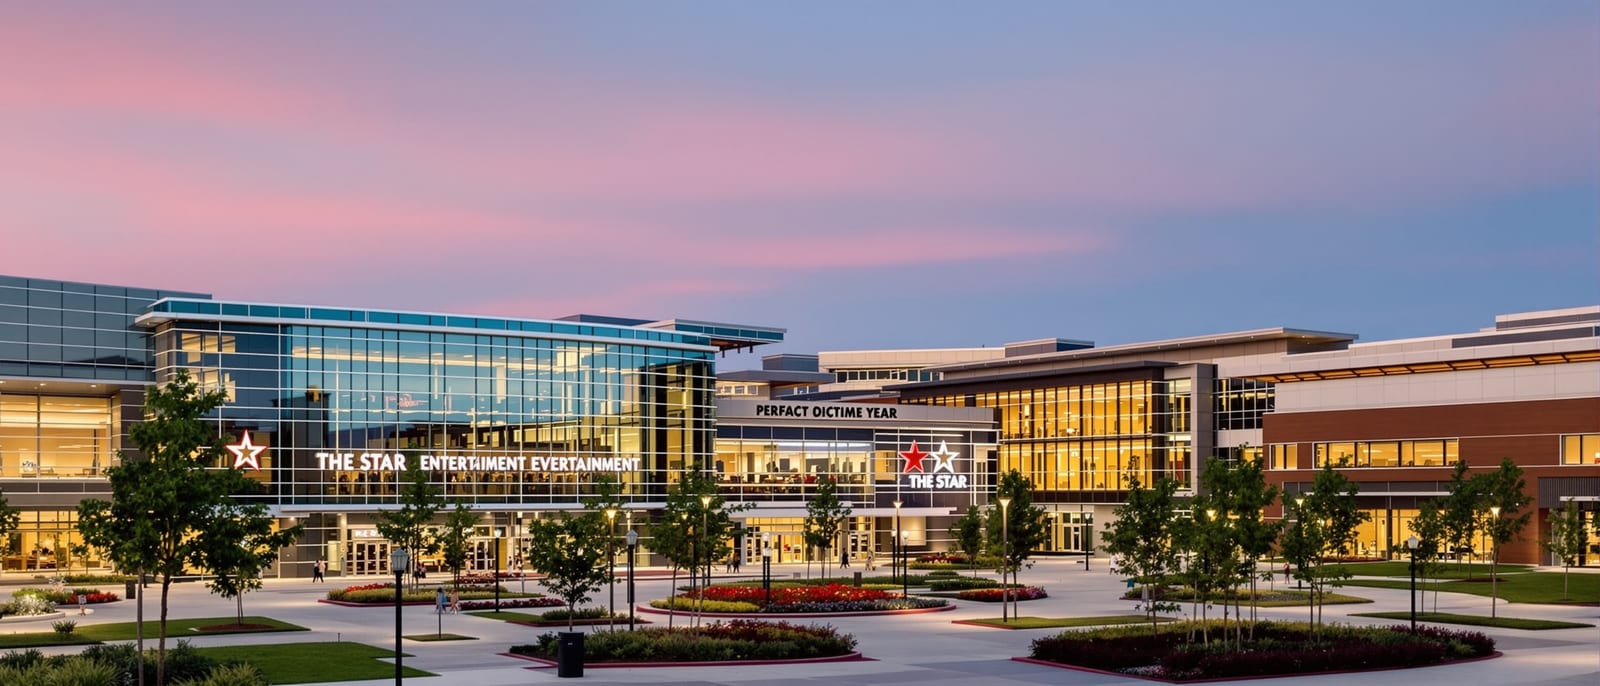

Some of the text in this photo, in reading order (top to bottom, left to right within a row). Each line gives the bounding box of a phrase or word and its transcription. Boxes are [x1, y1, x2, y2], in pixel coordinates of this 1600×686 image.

[756, 405, 809, 417] PERFACT
[866, 407, 898, 418] YEAR
[315, 452, 355, 471] THE
[359, 452, 407, 471] STAR
[531, 456, 641, 472] EVERTAINMENT
[908, 474, 968, 489] THE STAR
